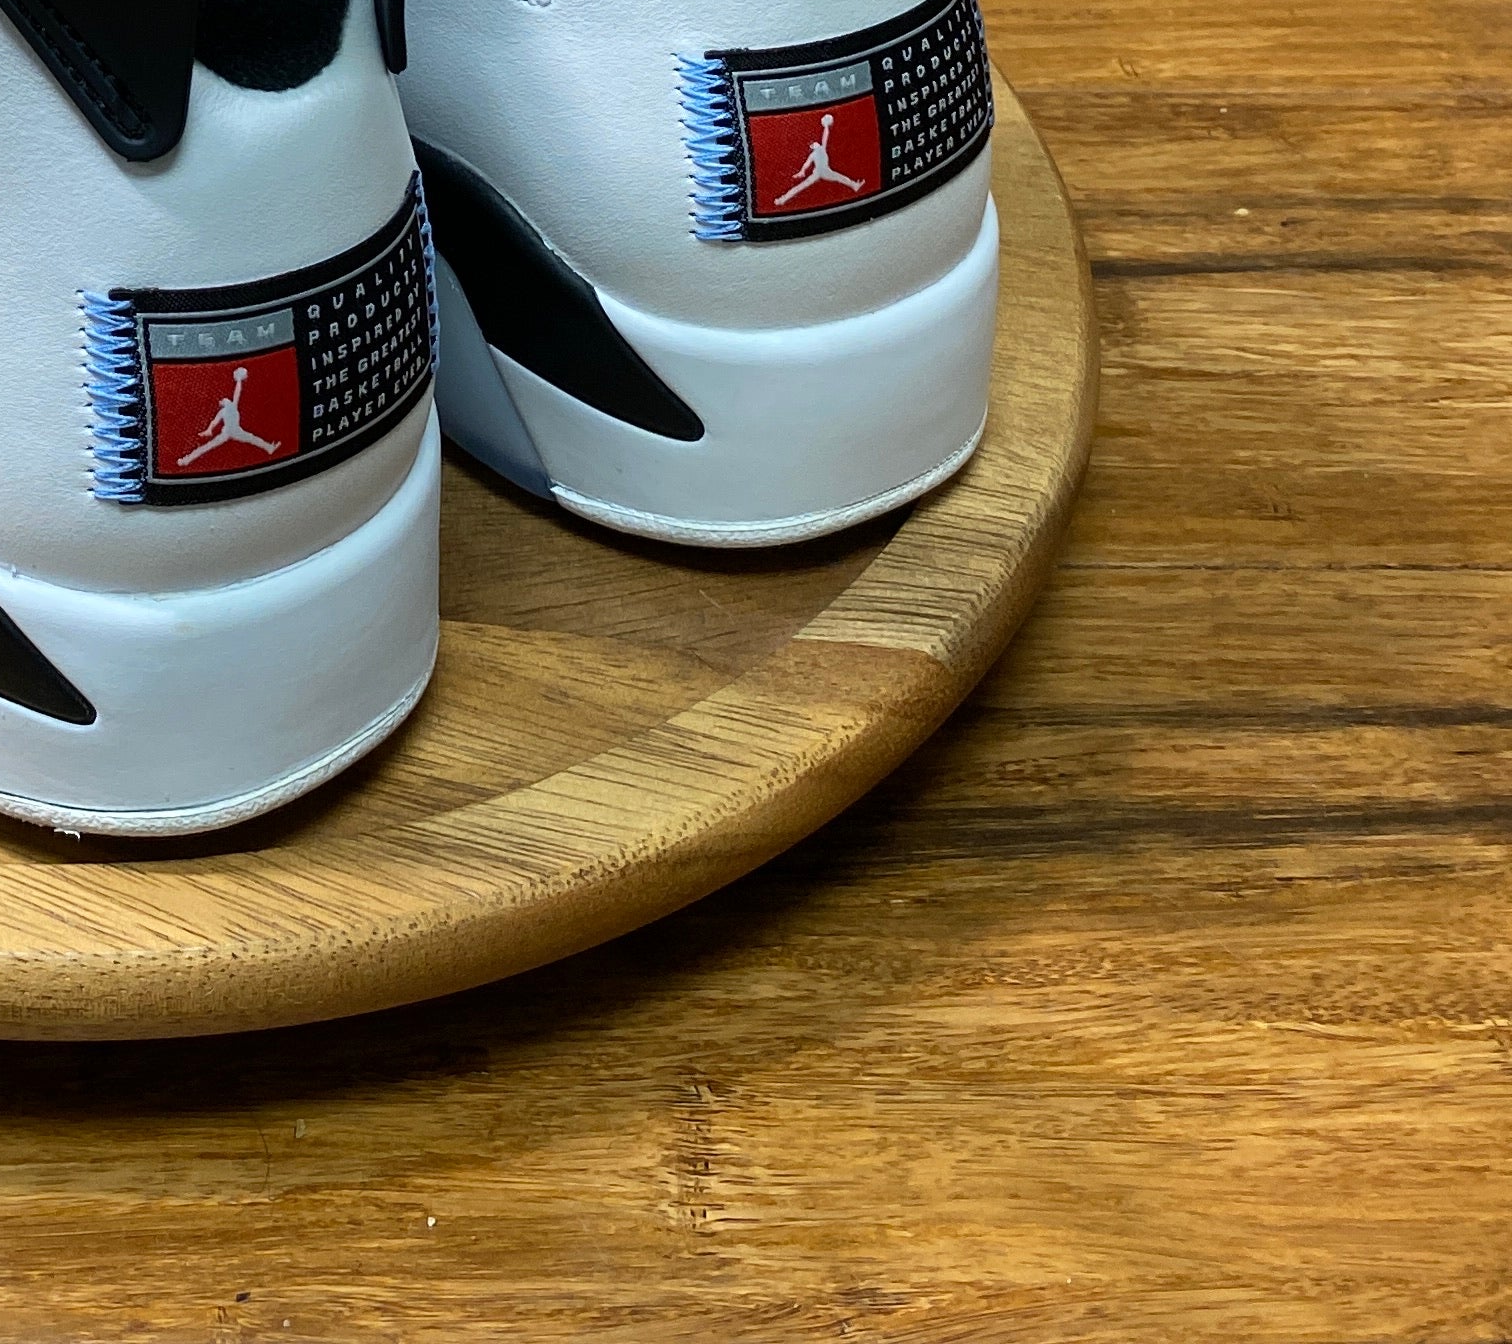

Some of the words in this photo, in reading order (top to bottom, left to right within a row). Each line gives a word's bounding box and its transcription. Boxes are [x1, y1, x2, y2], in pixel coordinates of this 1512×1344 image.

[759, 72, 856, 99] TEAM
[883, 20, 972, 94] PRODUCTS
[887, 60, 963, 116] INSPIRED
[889, 112, 922, 138] THE
[926, 62, 980, 119] GREATEST
[891, 87, 982, 160] BASKETBALL
[891, 135, 955, 181] PLAYER
[306, 232, 414, 320] QUALITY
[308, 257, 417, 346] PRODUCTS
[165, 321, 276, 348] TEAM
[310, 306, 403, 371] INSPIRED
[407, 281, 420, 310] BY
[312, 366, 349, 394] THE
[357, 305, 422, 375] GREATEST
[312, 333, 423, 420] BASKETBALL
[311, 391, 387, 443] PLAYER
